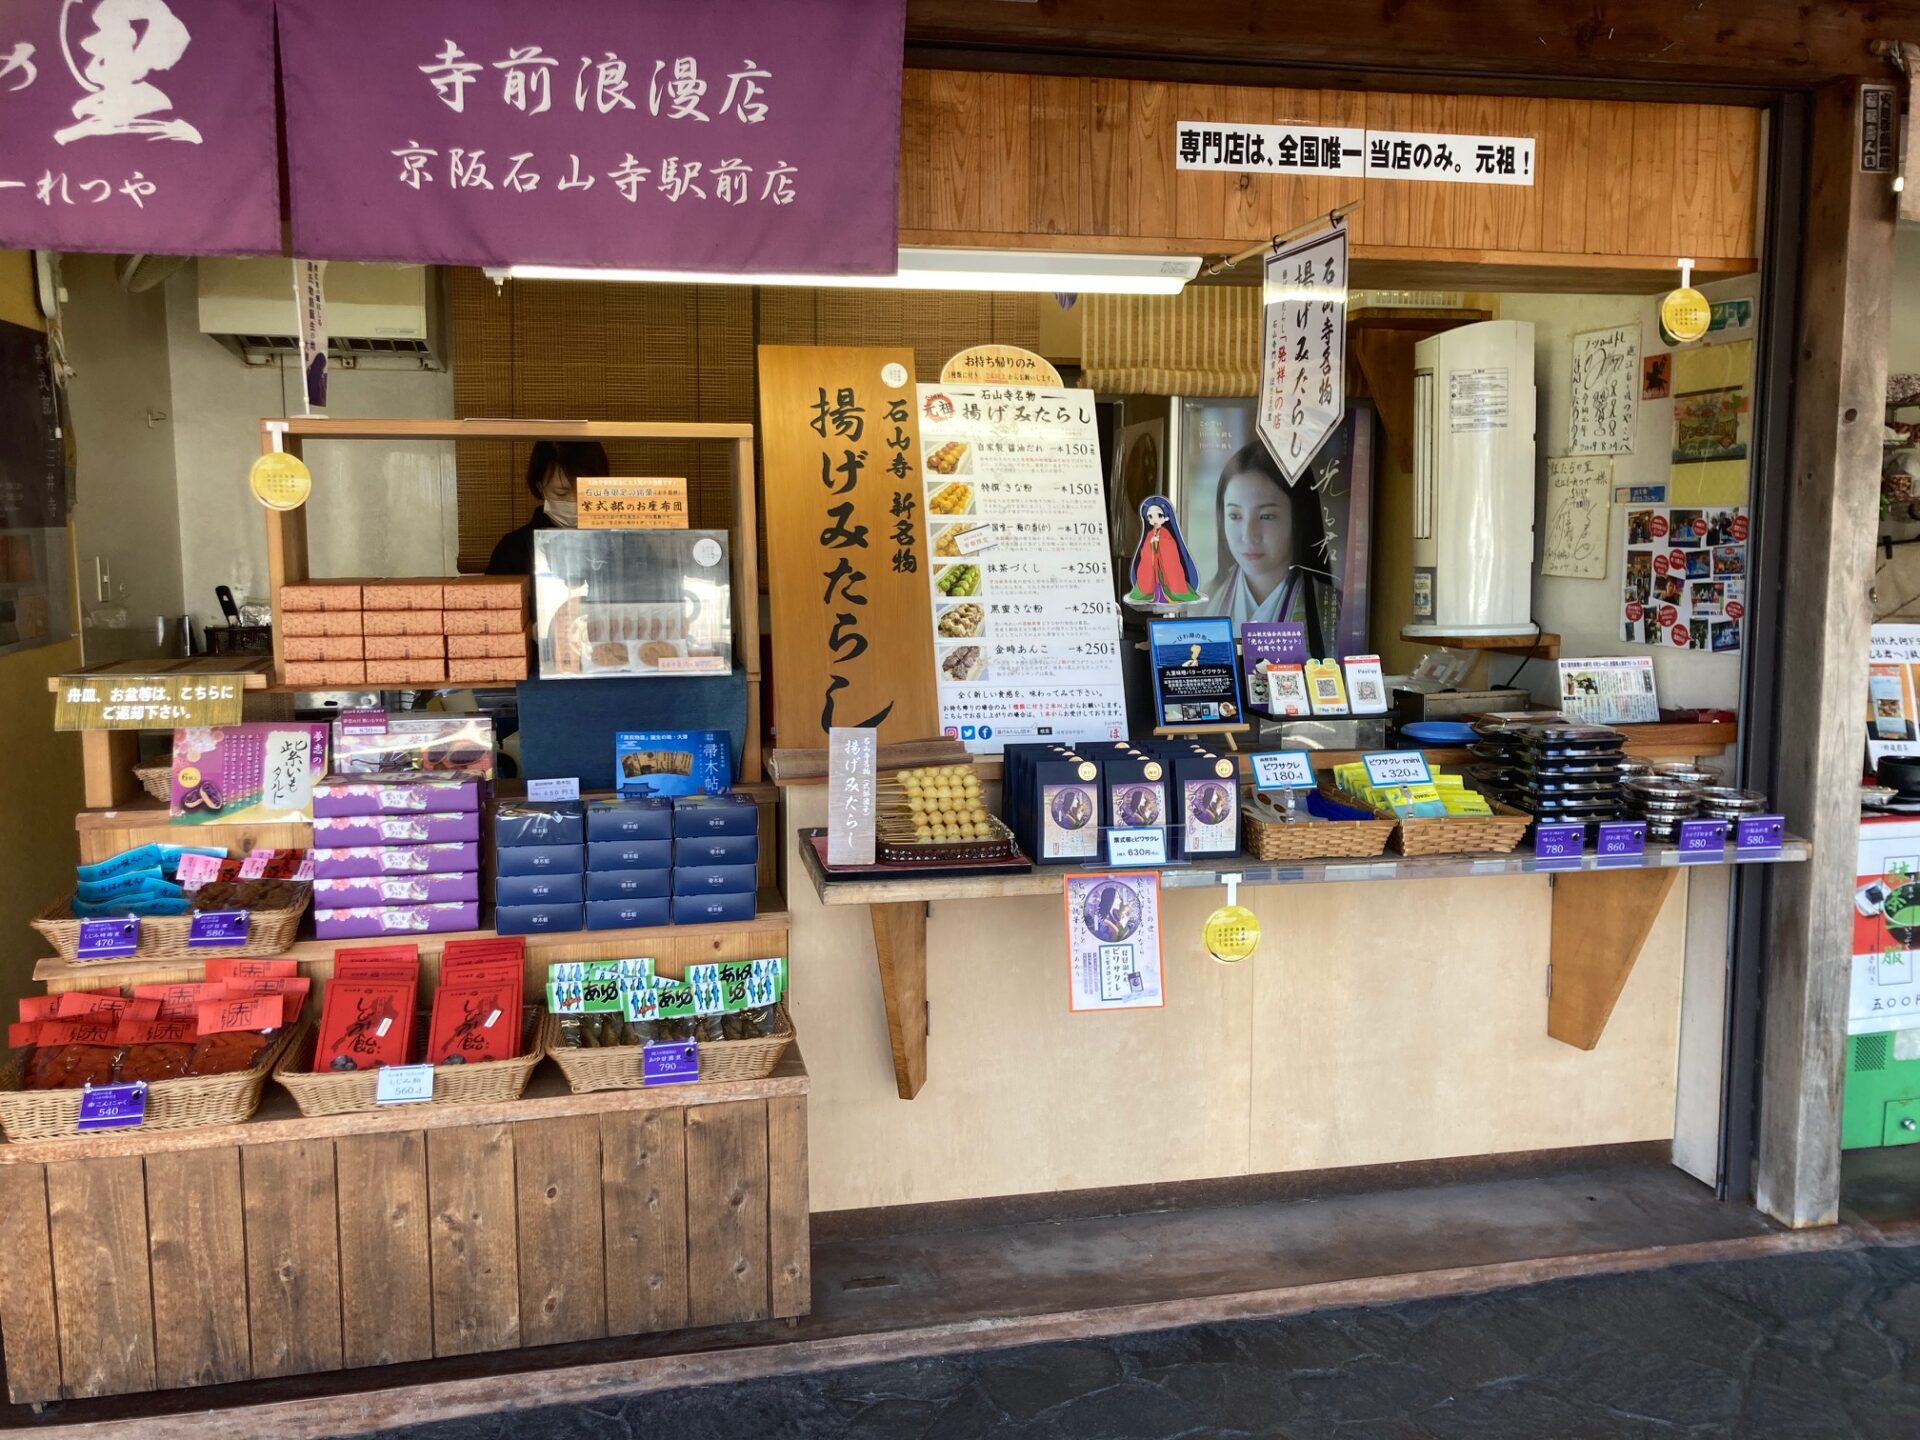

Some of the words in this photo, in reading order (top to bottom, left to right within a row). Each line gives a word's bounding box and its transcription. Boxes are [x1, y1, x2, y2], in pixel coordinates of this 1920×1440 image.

[418, 39, 772, 124] 寺前浪漫店
[1180, 129, 1362, 169] 専門店は、全国唯一
[391, 140, 798, 206] 京阪石山寺駅前店
[965, 355, 1037, 368] お持ち帰りのみ
[981, 389, 1037, 402] 石山寺名物
[962, 403, 1092, 425] 揚げみたらし
[883, 399, 914, 480] 石山寺
[1005, 483, 1032, 493] きな粉
[581, 500, 683, 513] 紫式部のお座布団
[888, 492, 918, 574] 新名物
[809, 386, 895, 737] 揚げみたらし
[987, 563, 1041, 574] 抹茶づくし
[990, 604, 1043, 614] 黒蜜きな粉
[995, 644, 1049, 655] 金時あんこ
[67, 685, 234, 702] 舟皿、お盆等は、こちらに
[102, 705, 192, 720] ご返却下さい。
[281, 740, 307, 792] 紫いも
[1263, 761, 1301, 771] ビワサクレ
[1368, 758, 1401, 767] ビワサクレ
[1402, 756, 1421, 764] mini
[1273, 771, 1296, 781] 180
[1388, 768, 1411, 778] 320
[272, 766, 285, 805] タルト
[844, 739, 861, 849] 揚げみたらし
[1688, 839, 1707, 849] 580
[1746, 835, 1765, 845] 580
[1545, 844, 1564, 854] 780
[1607, 842, 1625, 852] 860
[95, 939, 114, 947] 470
[1112, 946, 1122, 991] ビワサクレ
[583, 980, 619, 1004] あゆ
[658, 986, 694, 1009] あゆ
[659, 1062, 677, 1072] 790
[98, 1107, 119, 1116] 540
